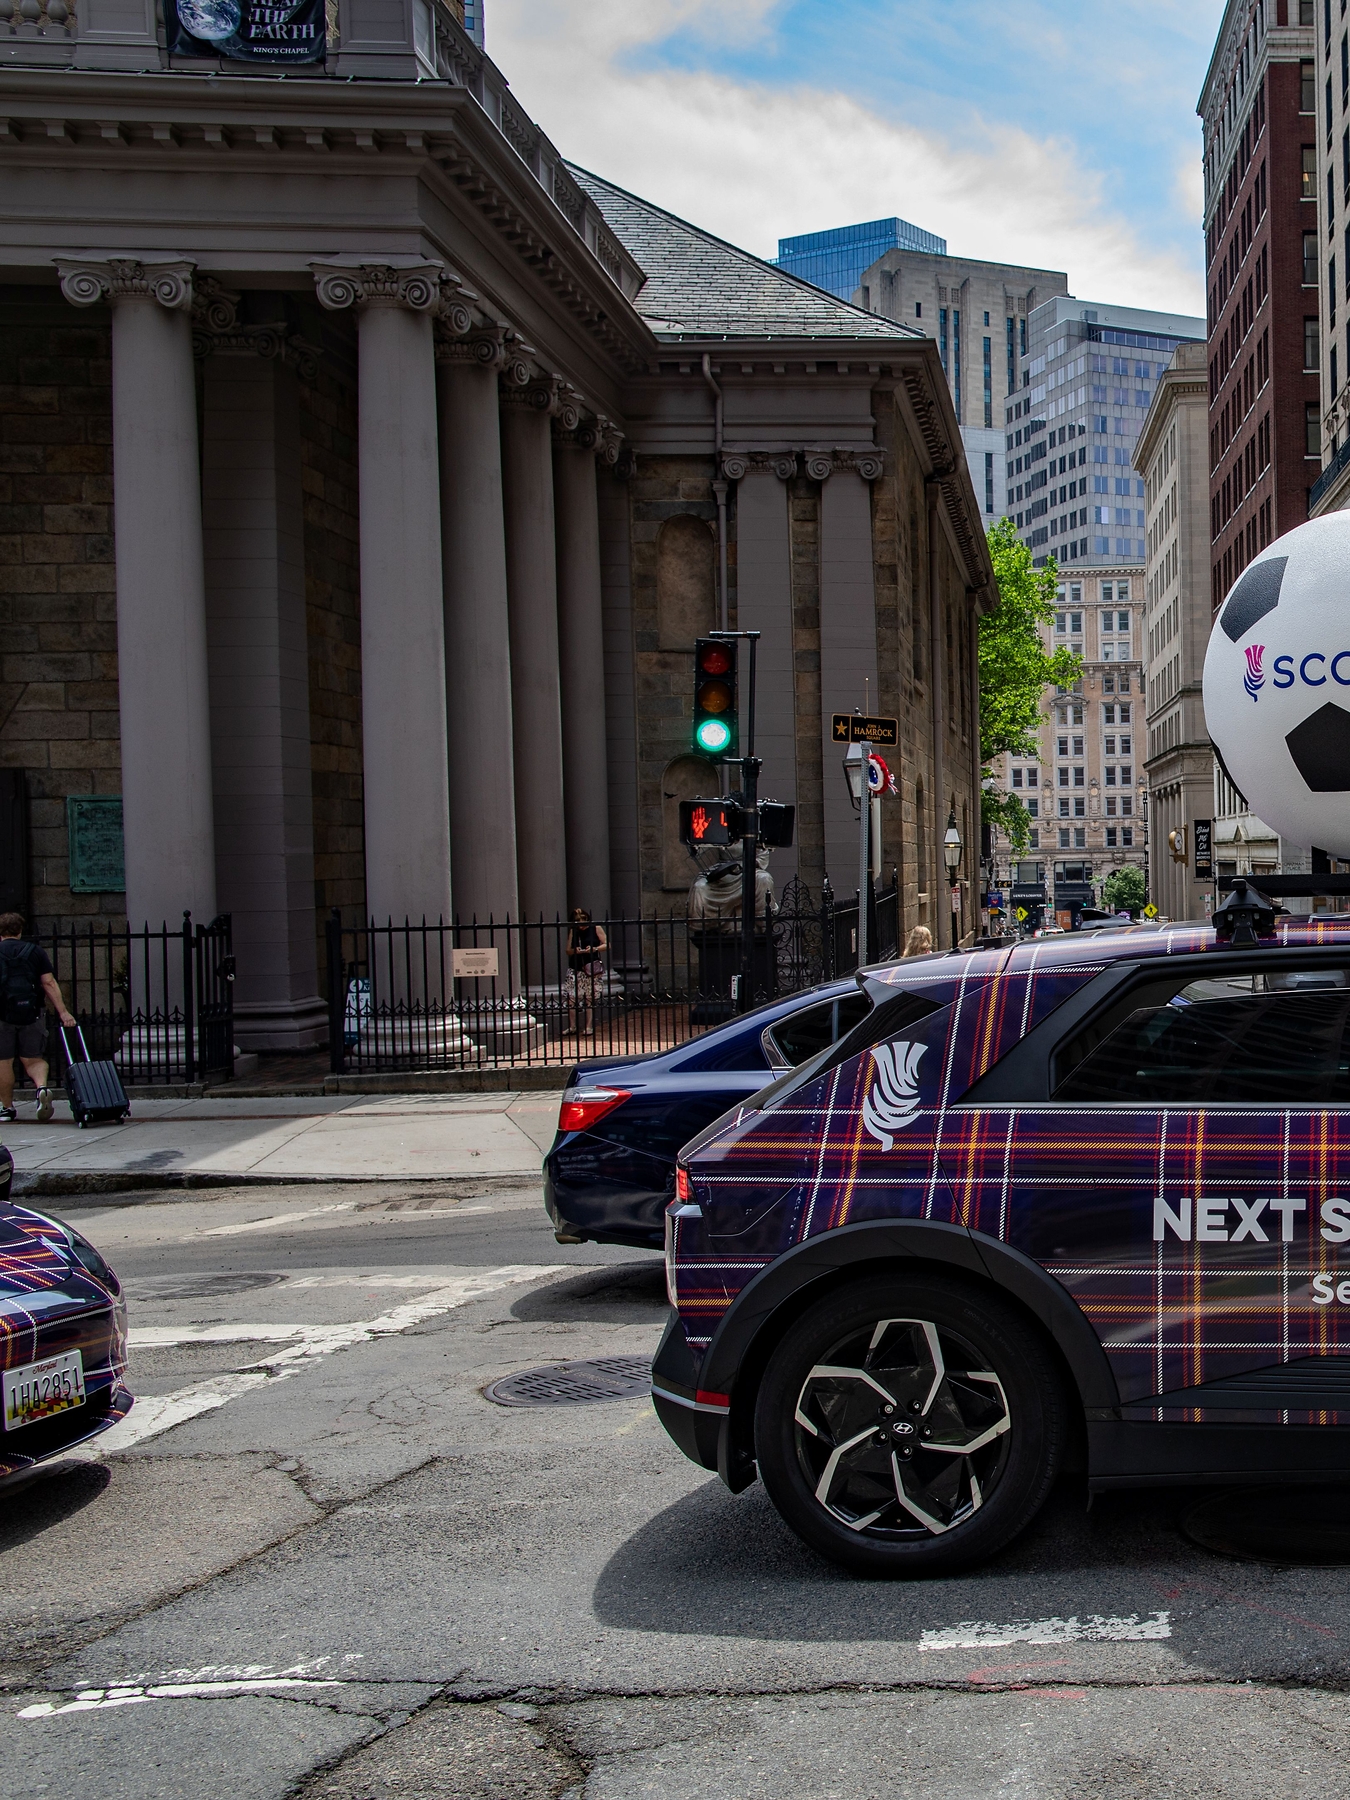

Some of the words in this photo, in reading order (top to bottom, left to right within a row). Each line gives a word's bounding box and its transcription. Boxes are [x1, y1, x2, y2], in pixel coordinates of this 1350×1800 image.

[251, 8, 290, 23] THE
[250, 24, 315, 39] EARTH
[854, 727, 893, 737] HAMROCK
[1153, 1198, 1306, 1242] NEXT
[33, 1359, 58, 1374] Maryland
[11, 1366, 79, 1419] 1HA2851
